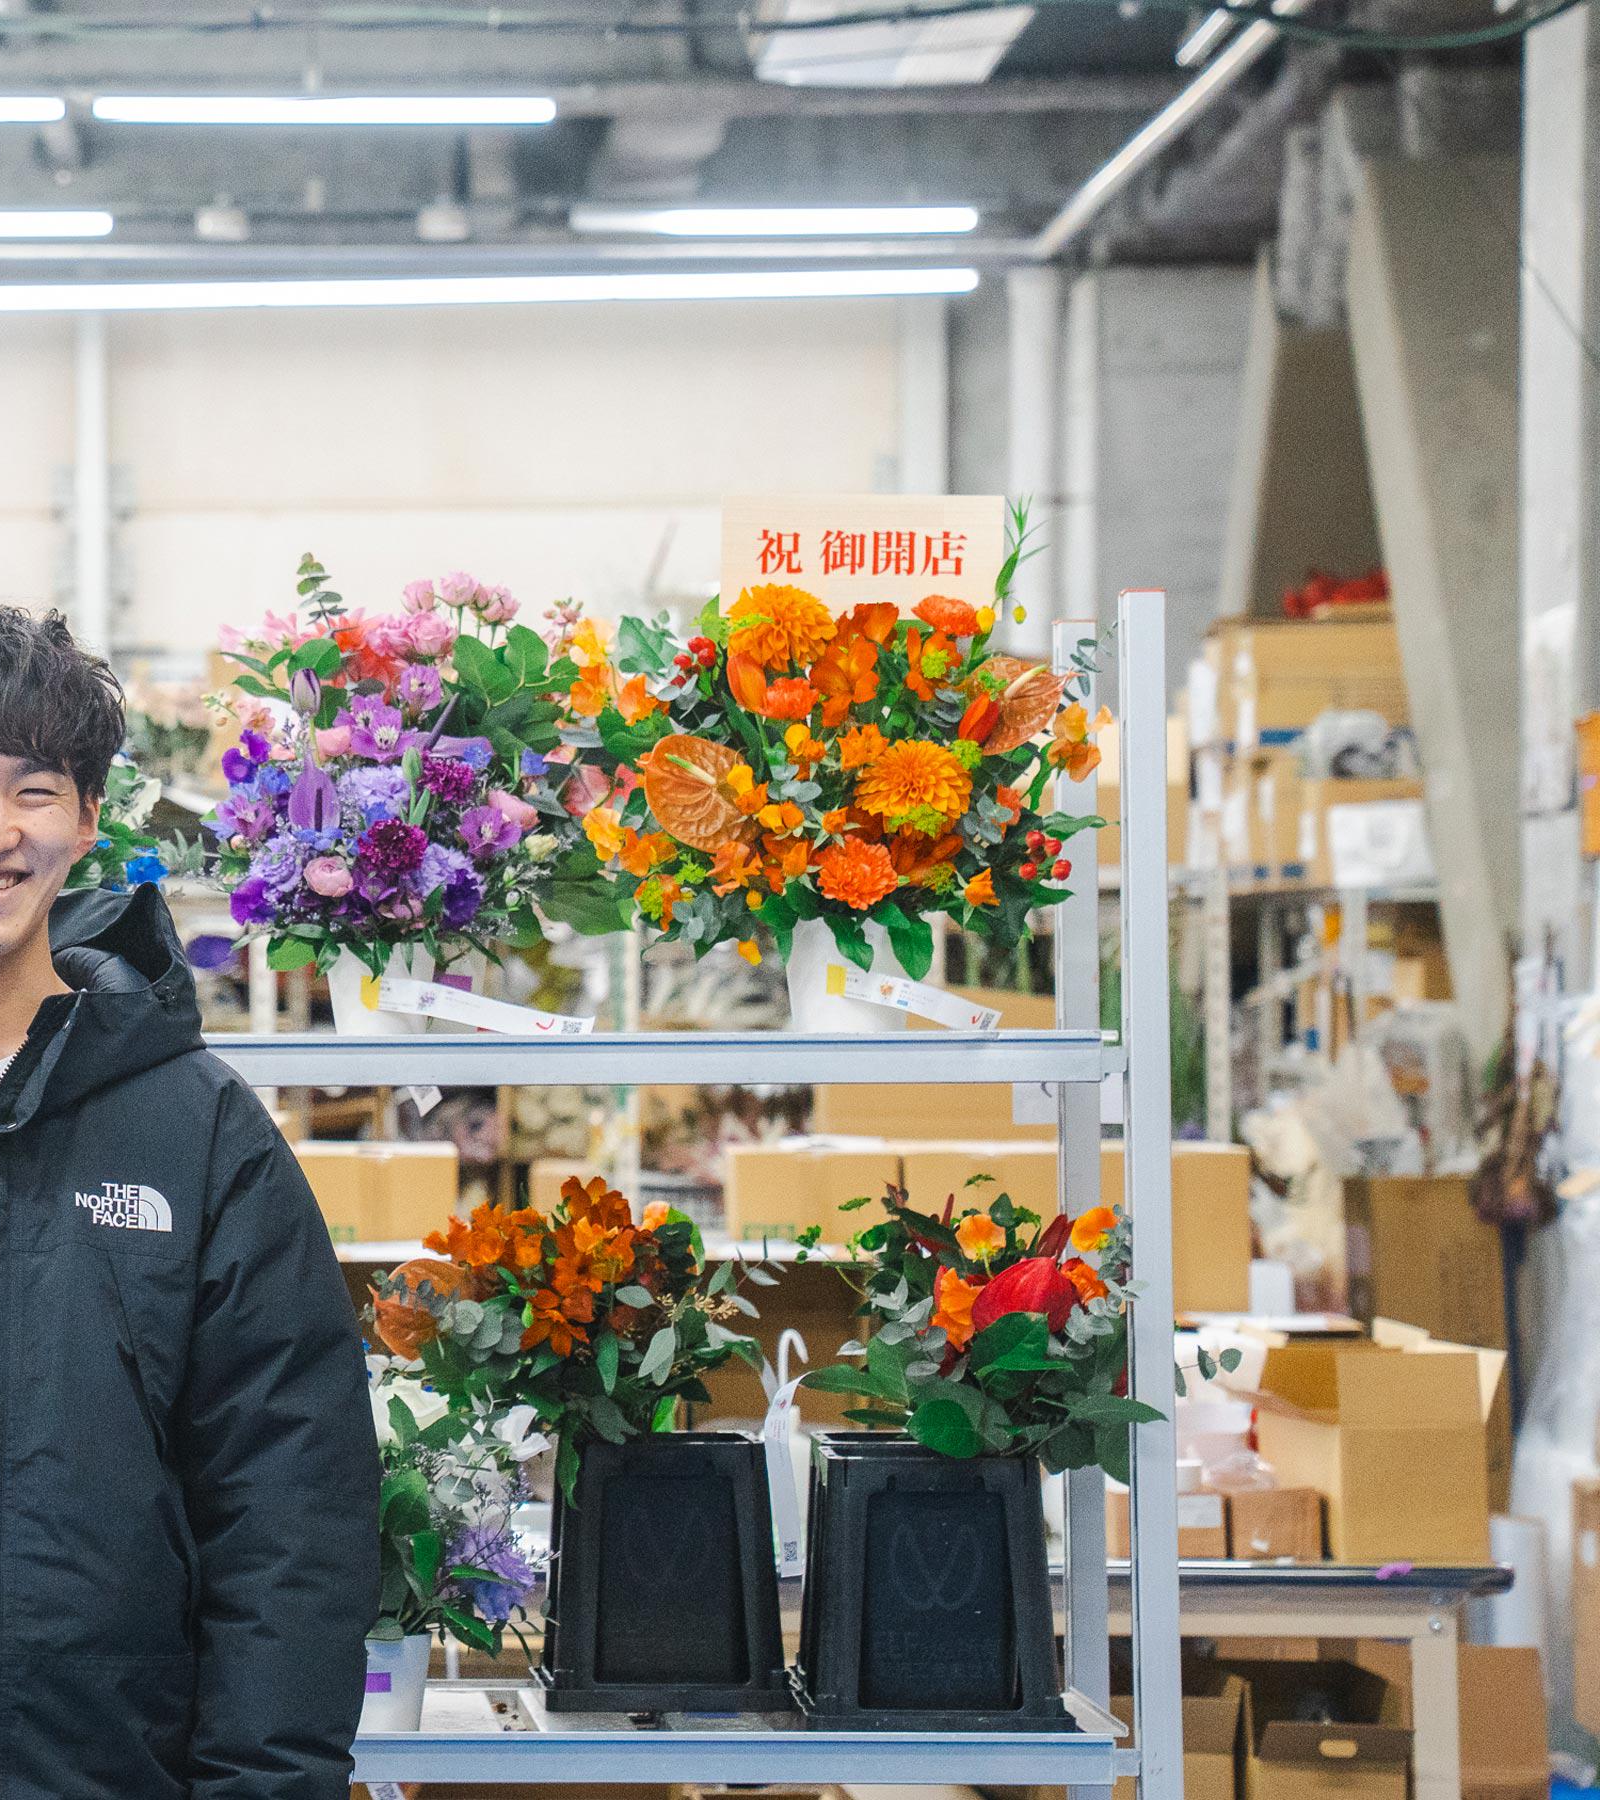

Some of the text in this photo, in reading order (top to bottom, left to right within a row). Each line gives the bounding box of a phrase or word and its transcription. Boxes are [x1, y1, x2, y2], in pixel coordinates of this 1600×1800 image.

[756, 529, 968, 576] 祝 御開店
[101, 1182, 139, 1200] THE
[75, 1191, 138, 1214] NORTH
[92, 1209, 139, 1229] FACE
